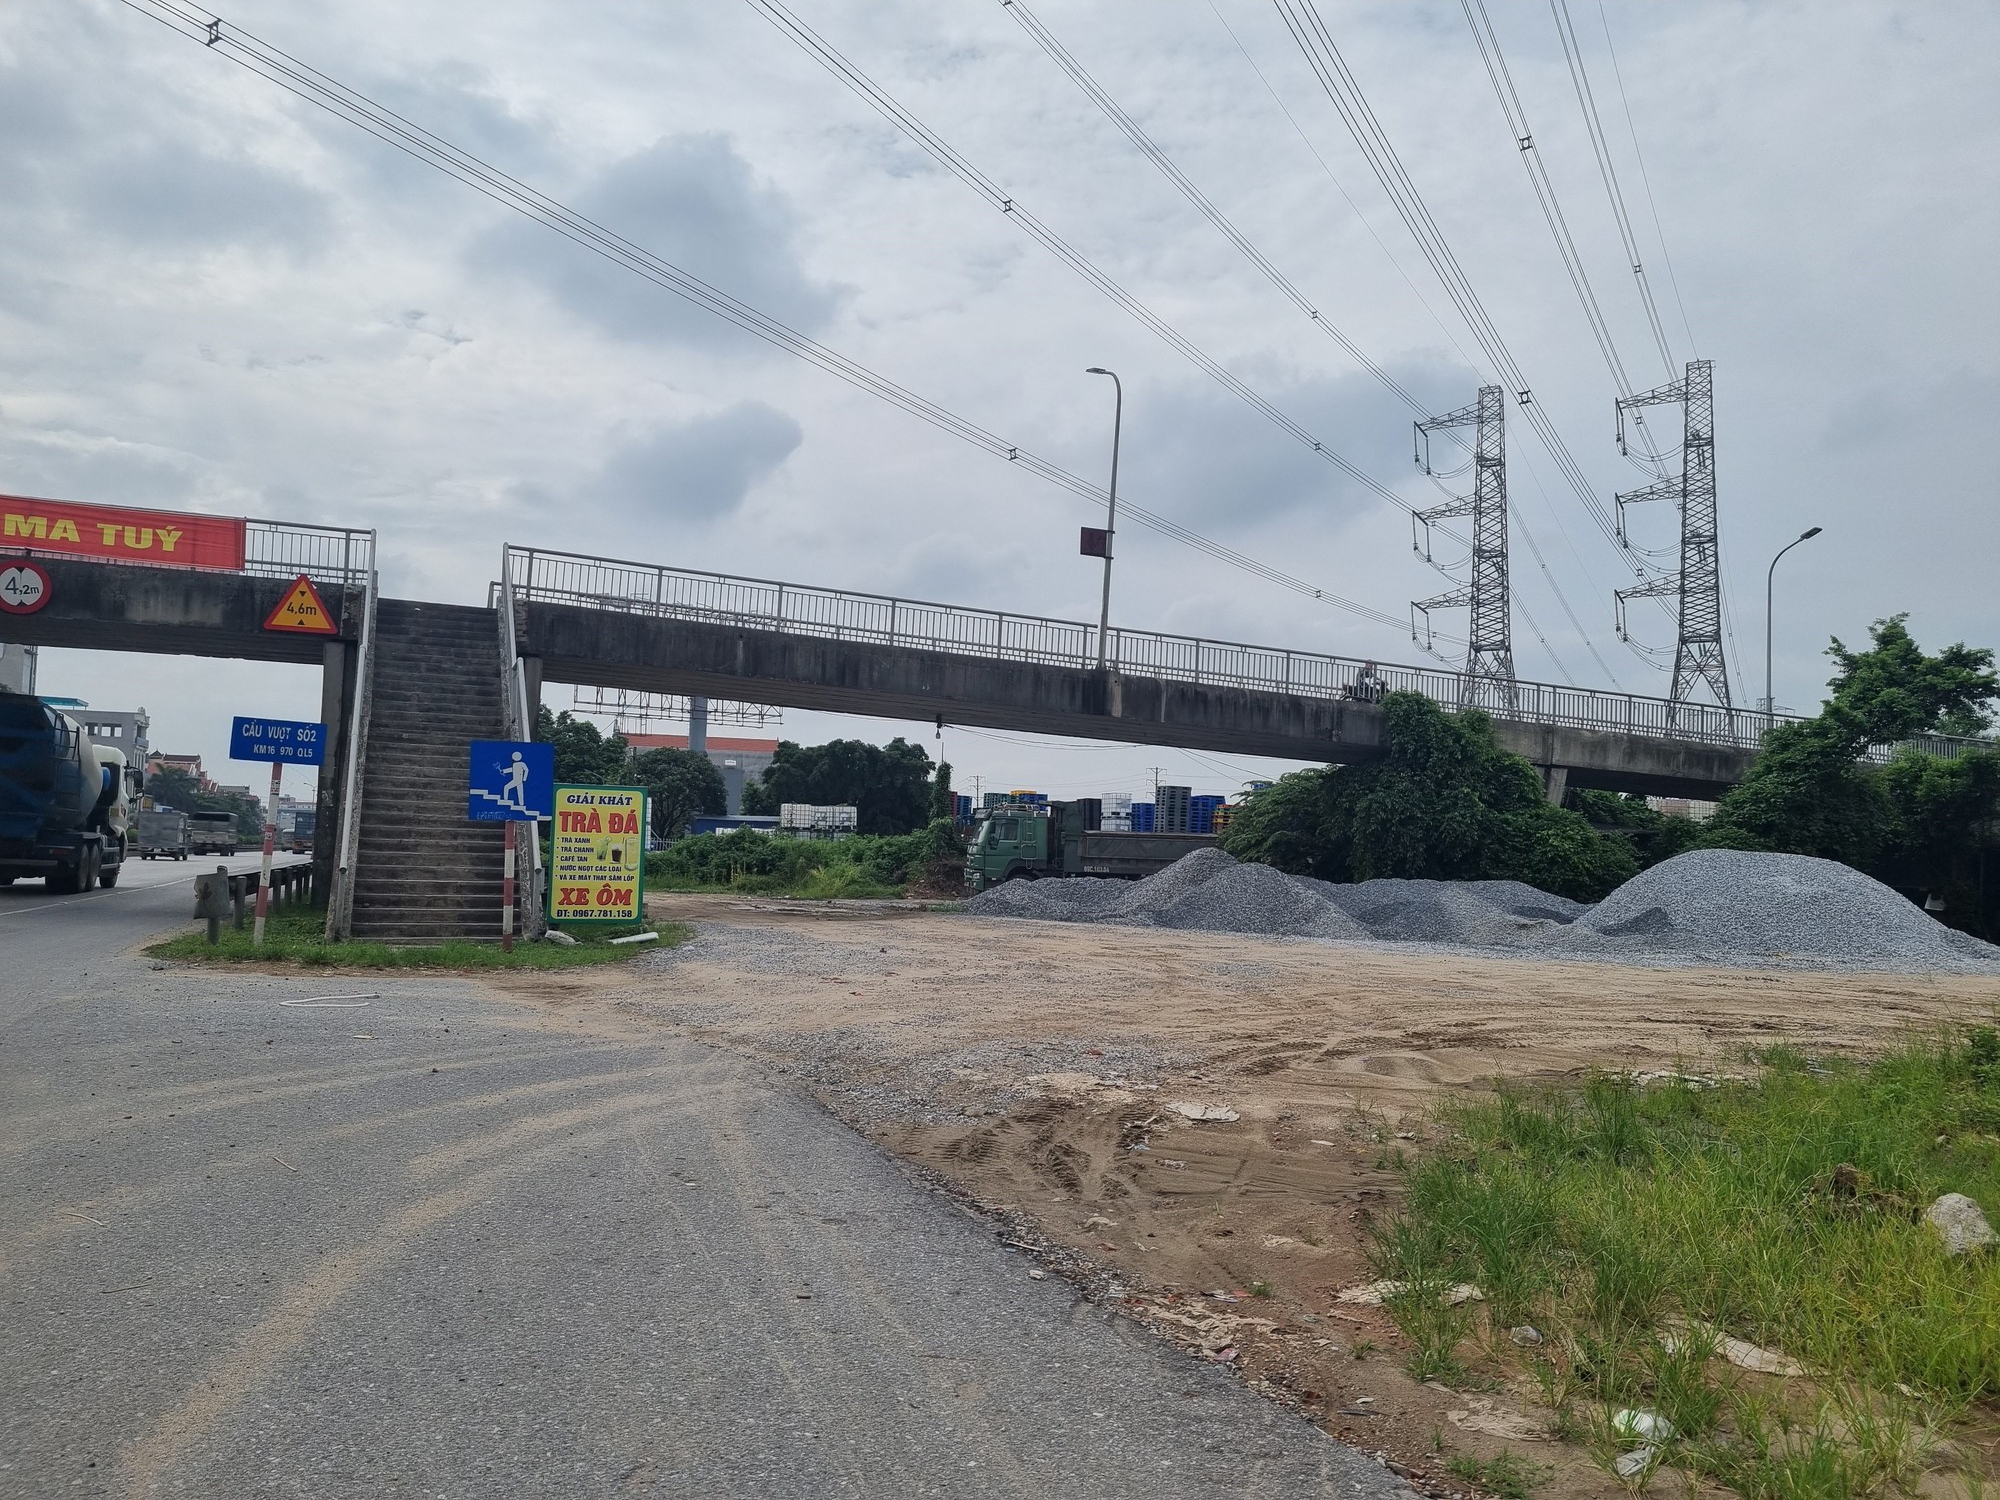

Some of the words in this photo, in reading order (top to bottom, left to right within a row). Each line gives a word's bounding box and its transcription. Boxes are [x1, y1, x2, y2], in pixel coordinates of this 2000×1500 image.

[4, 513, 81, 543] MA
[97, 523, 183, 552] TUÝ
[4, 576, 40, 595] 4,2m
[286, 601, 317, 616] 4,6m
[242, 719, 263, 737] CẦU
[253, 744, 276, 755] KM16
[280, 746, 293, 756] 970
[297, 748, 313, 758] QL5
[598, 794, 633, 806] KHÁT
[559, 808, 602, 833] TRÀ
[608, 809, 639, 834] ĐÁ
[558, 888, 590, 906] XE
[597, 883, 633, 906] ÔM
[573, 910, 633, 918] 0967.781.158
